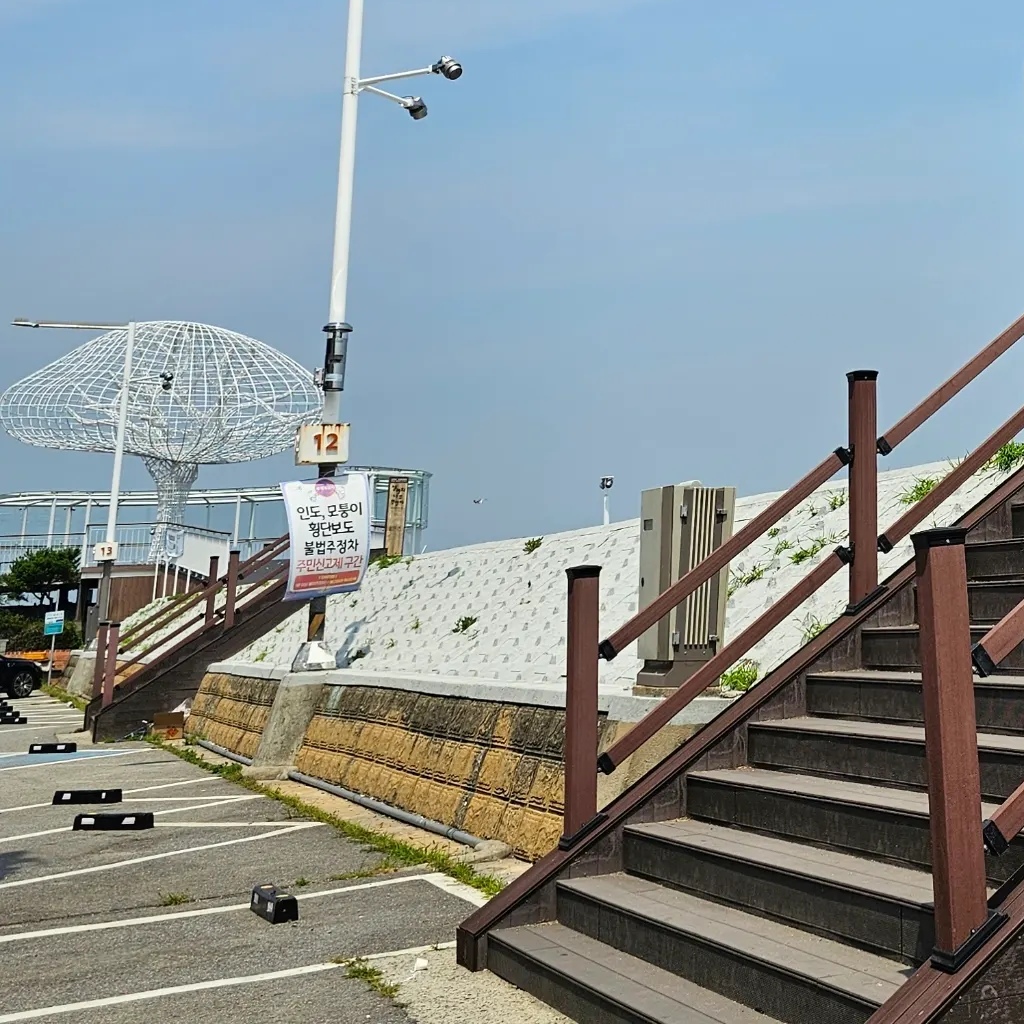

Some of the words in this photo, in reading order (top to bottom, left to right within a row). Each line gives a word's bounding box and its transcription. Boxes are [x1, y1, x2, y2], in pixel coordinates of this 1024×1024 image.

[313, 433, 339, 452] 12
[296, 503, 326, 521] 인도,
[327, 502, 363, 517] 모퉁이
[308, 520, 355, 538] 횡단보도
[100, 546, 113, 557] 13
[304, 538, 359, 556] 불법주정차
[296, 558, 343, 572] 주민신고제
[343, 555, 364, 569] 구간
